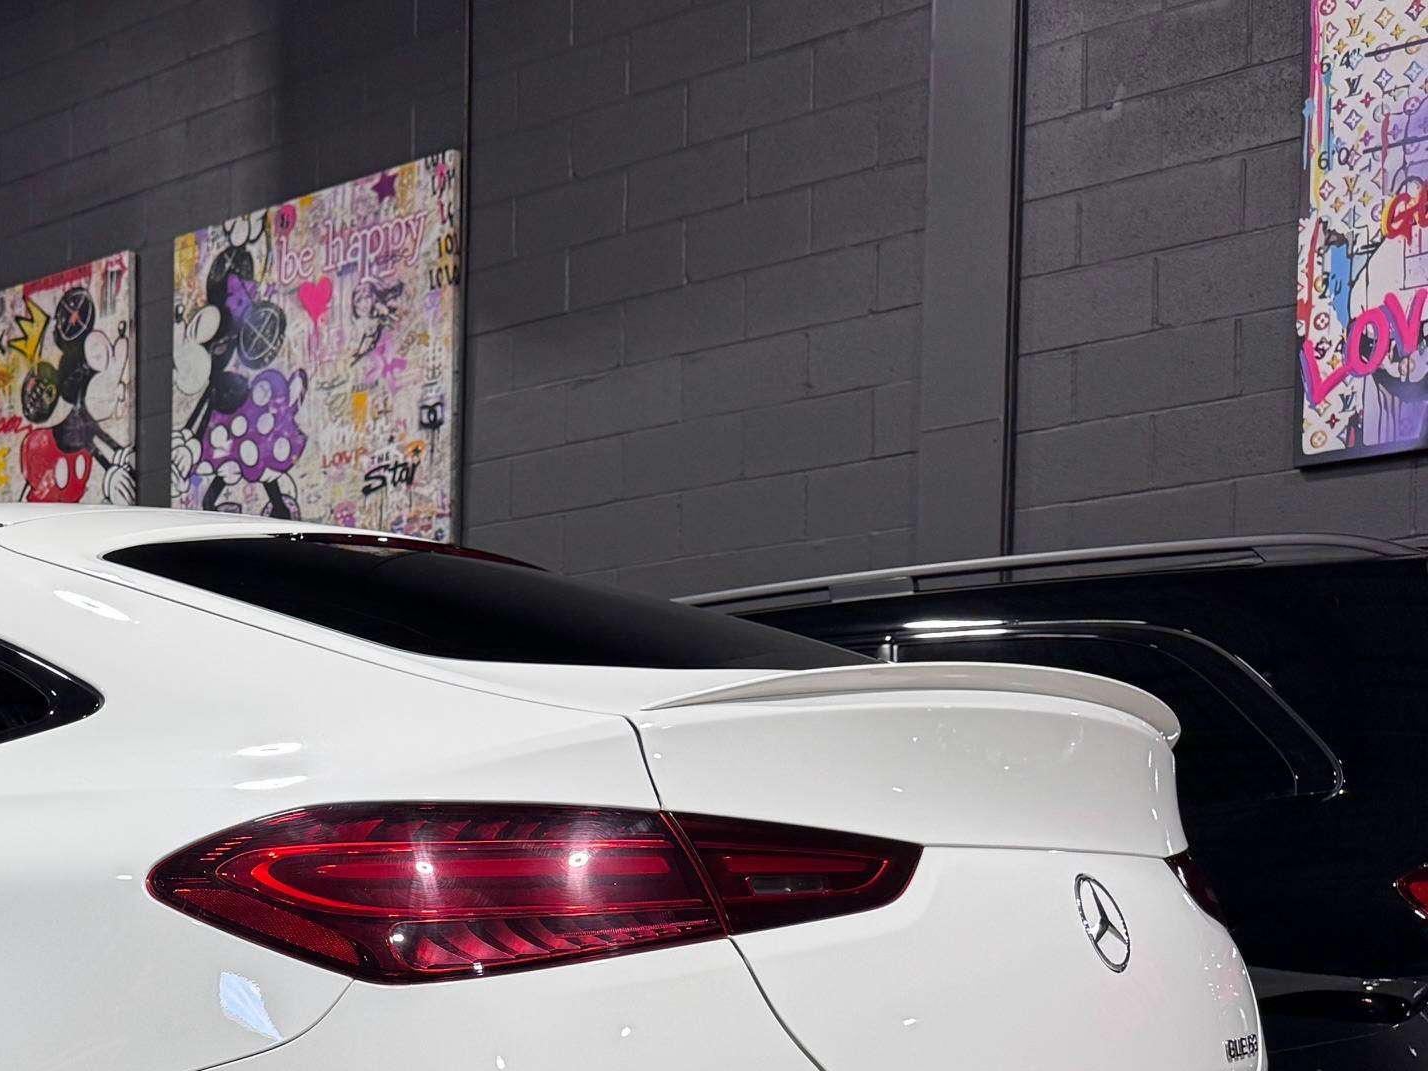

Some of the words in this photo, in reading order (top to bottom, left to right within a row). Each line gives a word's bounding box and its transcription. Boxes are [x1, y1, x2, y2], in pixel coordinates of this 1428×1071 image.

[278, 236, 314, 285] be
[323, 211, 428, 284] happy
[362, 461, 420, 495] Star
